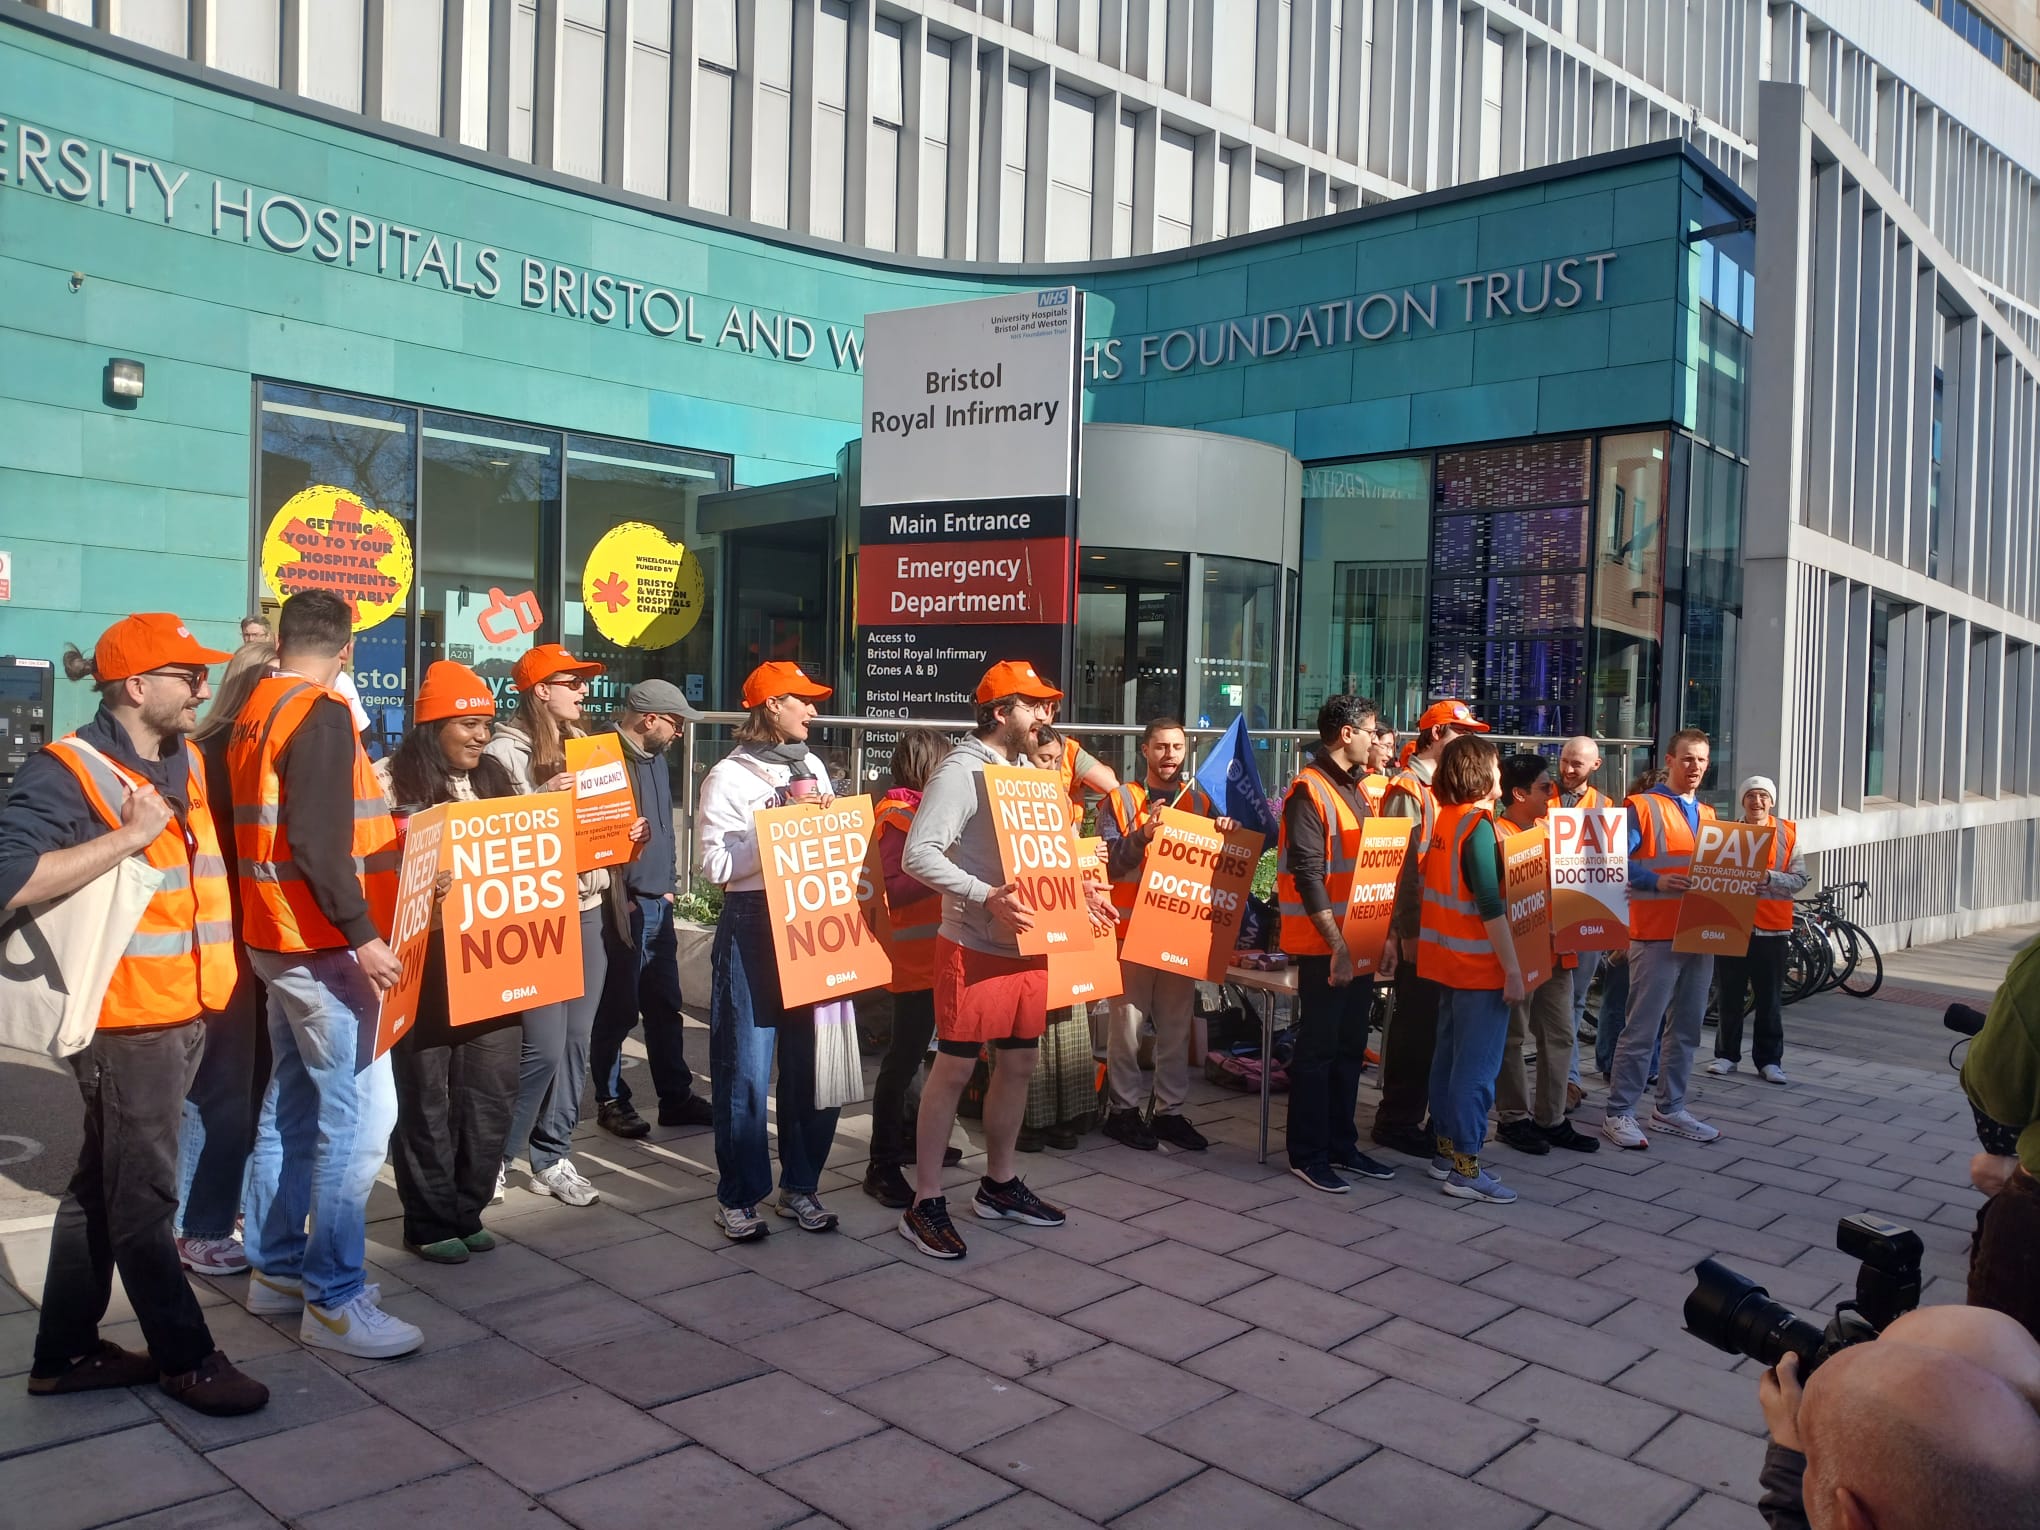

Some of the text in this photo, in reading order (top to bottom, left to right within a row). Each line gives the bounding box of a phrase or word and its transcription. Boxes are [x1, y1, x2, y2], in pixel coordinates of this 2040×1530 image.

[212, 180, 500, 299] HOSPITALS
[522, 257, 705, 344] BRISTOL
[716, 305, 815, 363] AND
[1039, 289, 1067, 306] NHS
[991, 308, 1068, 325] University Hospitals
[1140, 285, 1437, 376] FOUNDATION
[1456, 253, 1617, 323] TRUST
[994, 319, 1068, 334] Bristol and Weston
[926, 363, 1002, 394] Bristol
[872, 400, 1059, 437] Royal Infirmary
[306, 518, 373, 535] GETTING
[890, 513, 1031, 535] Main Entrance
[284, 532, 393, 554] YOU TO YOUR
[300, 551, 377, 569] HOSPITAL
[636, 564, 662, 572] FUNDED
[897, 557, 1021, 584] Emergency
[275, 566, 397, 588] APPOINTMENTS
[637, 578, 679, 590] BRISTOL
[637, 587, 687, 599] & WESTON
[637, 596, 691, 608] HOSPITALS
[637, 605, 681, 615] CHARITY
[891, 590, 1027, 618] Department
[867, 632, 916, 643] Access to
[867, 648, 987, 661] Bristol Royal Infirmary
[867, 664, 938, 677] (Zones A & B)
[470, 697, 490, 708] BMA
[866, 690, 970, 703] Bristol Heart Institu
[866, 706, 909, 719] (Zone C)
[866, 731, 899, 743] Bristol
[580, 771, 622, 790] NO VACANCY
[995, 779, 1058, 800] DOCTORS
[450, 808, 560, 841] DOCTORS
[769, 810, 864, 841] DOCTORS
[999, 800, 1063, 832] NEED
[410, 821, 443, 854] DOCTORS
[1163, 826, 1251, 859] PATIENTS NEED
[1364, 837, 1406, 848] PATIENTS NEED
[1554, 815, 1622, 854] PAY
[452, 832, 562, 880] NEED
[773, 833, 868, 877] NEED
[1010, 833, 1071, 875] JOBS
[1508, 844, 1542, 865] PATIENTS NEED
[1697, 825, 1770, 867] PAY
[1158, 838, 1247, 878] DOCTORS
[1361, 850, 1403, 868] DOCTORS
[1555, 856, 1623, 865] RESTORATION FOR
[403, 851, 438, 899] NEED
[1509, 857, 1543, 887] DOCTORS
[1555, 868, 1624, 884] DOCTORS
[1693, 865, 1761, 879] RESTORATION FOR
[784, 865, 874, 923] JOBS
[1016, 876, 1077, 911] NOW
[1149, 871, 1238, 911] DOCTORS
[1354, 882, 1396, 903] DOCTORS
[1690, 877, 1758, 896] DOCTORS
[459, 870, 565, 932] JOBS
[1144, 891, 1233, 928] NEED JOBS
[1350, 902, 1393, 920] NEED JOBS
[1512, 890, 1545, 922] DOCTORS
[395, 888, 432, 955] JOBS
[1513, 910, 1545, 937] NEED JOBS
[1587, 925, 1604, 935] BMA
[786, 907, 876, 961] NOW
[1053, 932, 1068, 943] BMA
[1709, 930, 1725, 940] BMA
[460, 916, 566, 974] NOW
[1170, 953, 1189, 967] BMA
[836, 970, 857, 984] BMA
[513, 985, 538, 1000] BMA
[1079, 982, 1094, 995] BMA
